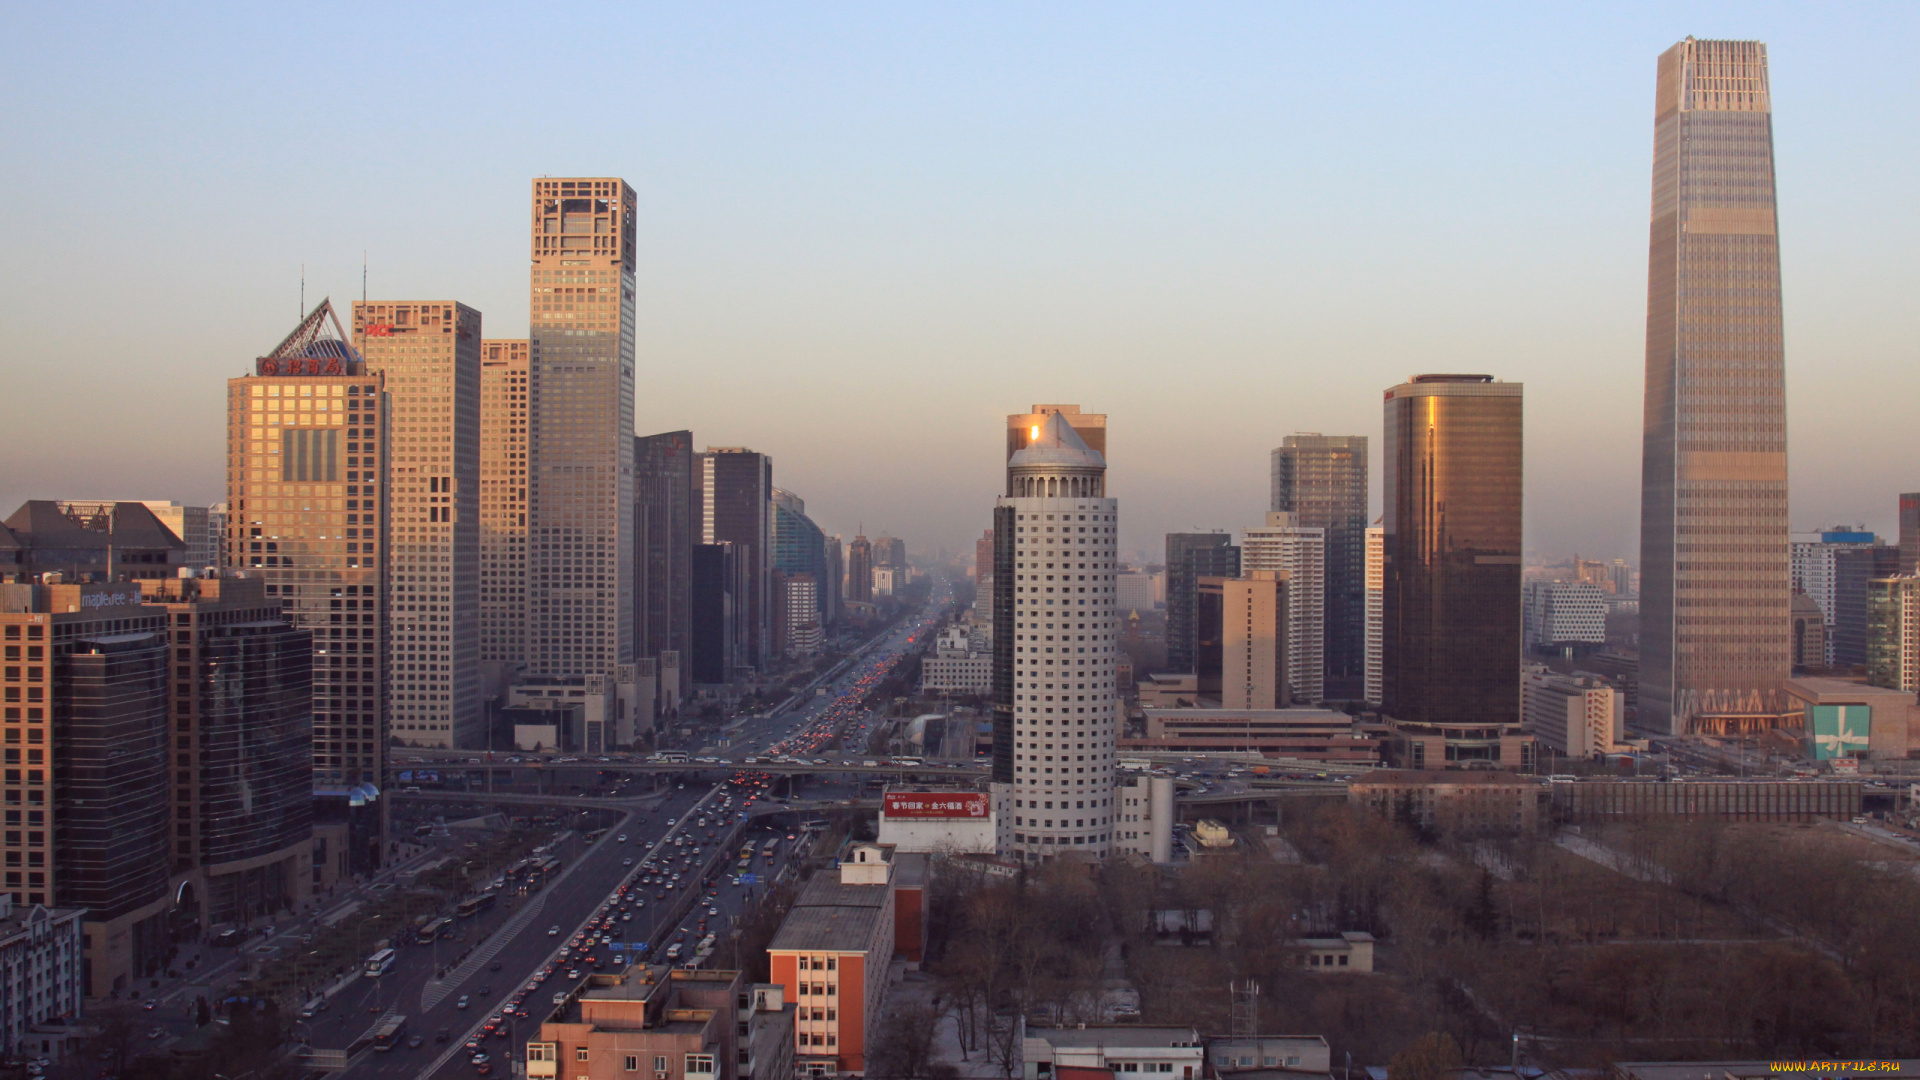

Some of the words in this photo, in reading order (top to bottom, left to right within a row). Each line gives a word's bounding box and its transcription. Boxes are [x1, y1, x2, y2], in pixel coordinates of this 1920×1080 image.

[365, 324, 394, 337] PICC
[287, 359, 340, 374] 招商局
[892, 801, 924, 810] 春节回家
[931, 801, 963, 810] 金六福酒
